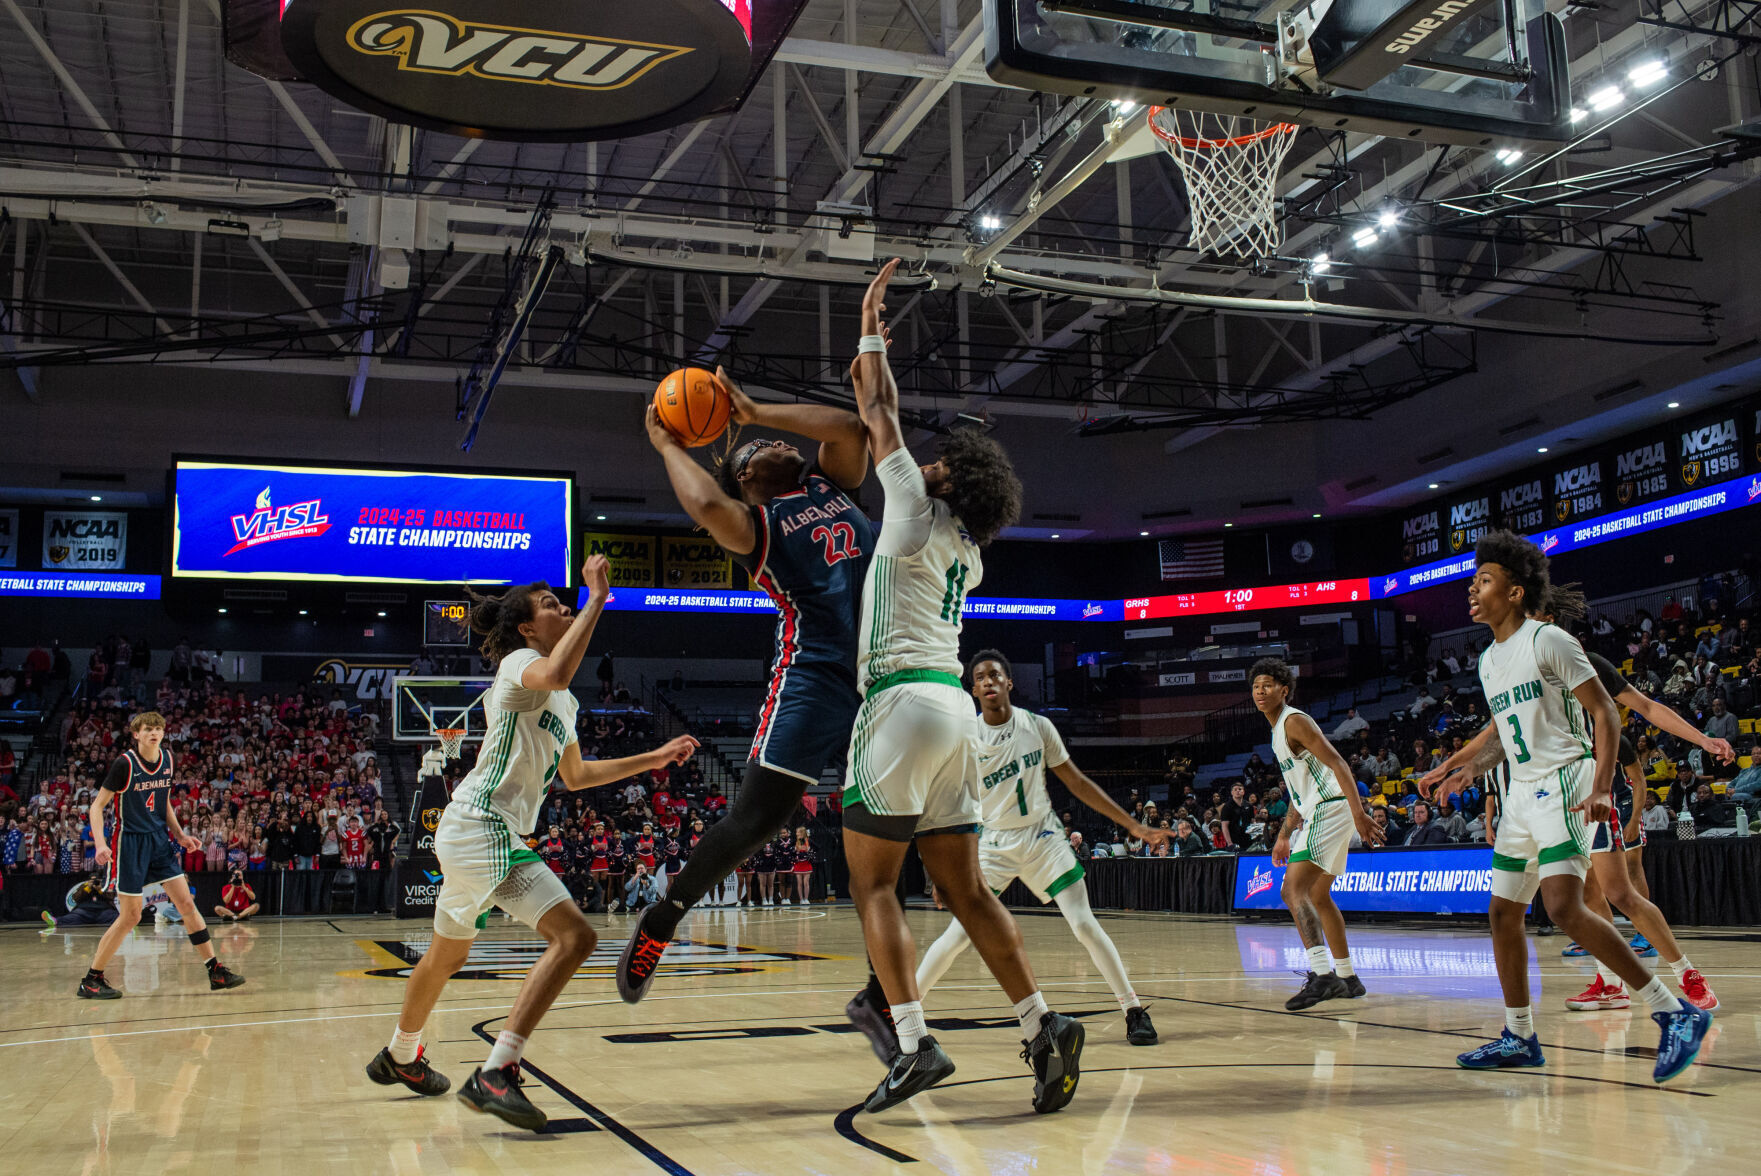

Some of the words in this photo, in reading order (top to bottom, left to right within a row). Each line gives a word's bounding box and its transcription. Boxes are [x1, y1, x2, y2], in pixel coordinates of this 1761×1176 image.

[1385, 0, 1476, 53] urams
[354, 12, 664, 86] VCU
[1682, 419, 1738, 457] NCAA
[1616, 441, 1666, 477] NCAA
[1704, 452, 1740, 477] 1996
[1554, 462, 1602, 495] NCAA
[1636, 474, 1668, 497] 1985
[1501, 480, 1543, 511] NCAA
[1573, 492, 1602, 515] 1984
[232, 499, 328, 541] VHSL
[358, 507, 426, 526] 2024-25
[432, 510, 526, 530] BASKETBALL
[1451, 497, 1490, 526] NCAA
[1516, 509, 1543, 530] 1983
[1574, 524, 1600, 542] 2024-25
[1602, 513, 1642, 536] BASKETBALL
[1643, 507, 1663, 525] STATE
[1664, 492, 1726, 518] CHAMPIONSHIPS
[51, 519, 119, 539] NCAA
[1403, 511, 1440, 539] NCAA
[247, 534, 270, 546] SERVING
[270, 531, 289, 540] YOUTH
[289, 528, 304, 537] SINCE
[348, 527, 397, 546] STATE
[399, 528, 531, 550] CHAMPIONSHIPS
[811, 521, 862, 567] 22
[77, 548, 117, 562] 2019
[590, 540, 649, 560] NCAA
[667, 544, 726, 562] NCAA
[613, 567, 650, 582] 2009
[691, 571, 727, 584] 2021
[1409, 571, 1431, 586] 2024-25
[1431, 563, 1462, 580] BASKETBALL
[1462, 559, 1475, 572] STAT
[36, 579, 65, 591] STATE
[66, 580, 146, 593] CHAMPIONSHIPS
[941, 557, 969, 627] 11
[1224, 589, 1253, 603] 1:00
[1316, 582, 1336, 592] AHS
[1351, 591, 1358, 600] 8
[645, 595, 679, 606] 2024-25
[680, 596, 728, 607] BASKETBALL
[729, 597, 752, 608] STATE
[961, 604, 972, 613] ALL
[974, 604, 995, 613] STATE
[996, 604, 1056, 614] CHAMPIONSHIPS
[1125, 599, 1150, 608] GRHS
[441, 606, 464, 619] 1:00
[1140, 609, 1146, 618] 8
[1164, 675, 1189, 684] SCOTT
[1512, 679, 1544, 705] RUN
[1507, 713, 1531, 764] 3
[983, 760, 1020, 790] GREEN
[1280, 757, 1294, 773] UN
[133, 778, 171, 792] ALBEMARLE
[145, 791, 155, 812] 4
[1016, 778, 1028, 817] 1
[351, 841, 359, 851] 2
[417, 835, 437, 854] Kro
[1247, 871, 1273, 894] VHSL
[1386, 871, 1419, 892] STATE
[1420, 870, 1493, 892] CHAMPIONS
[404, 896, 434, 905] Credit
